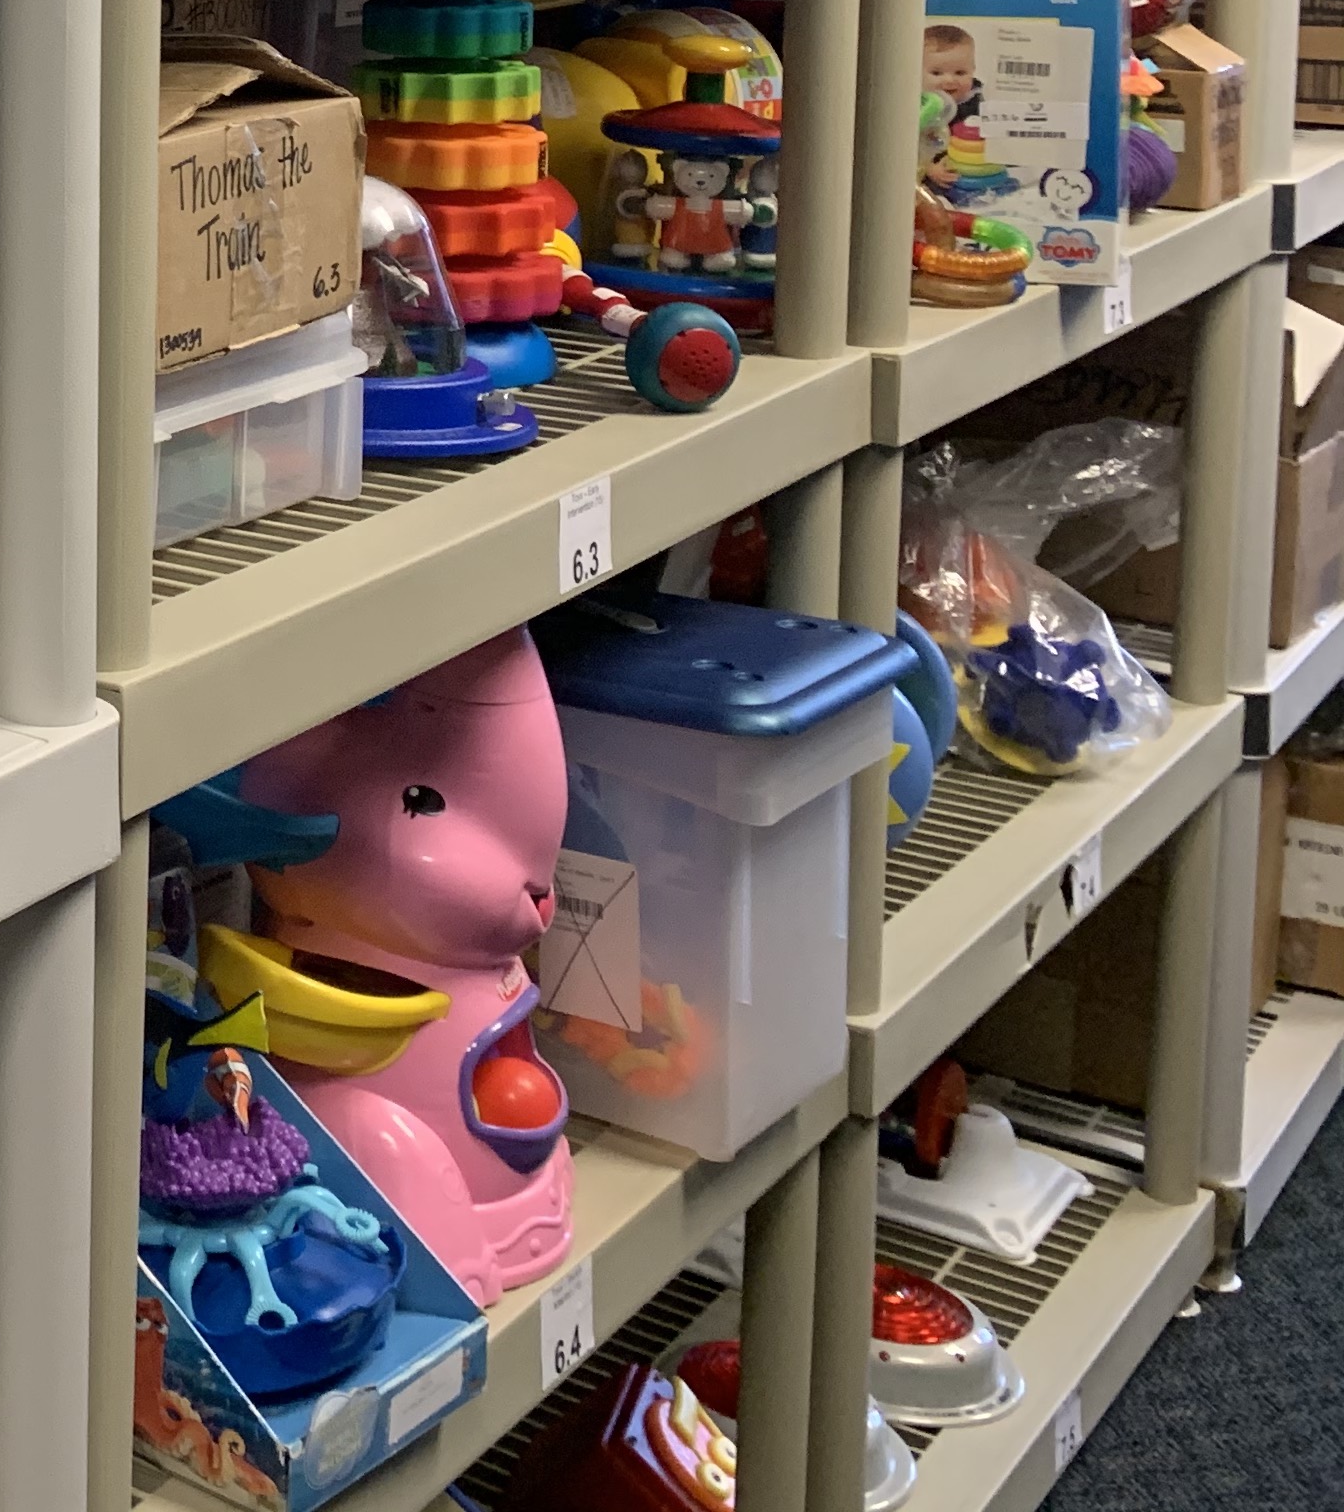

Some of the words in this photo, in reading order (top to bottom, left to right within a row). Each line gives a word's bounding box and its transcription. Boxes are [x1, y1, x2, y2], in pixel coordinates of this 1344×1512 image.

[171, 146, 266, 214] Thomas
[277, 135, 313, 190] the
[196, 211, 267, 282] Train
[1041, 244, 1098, 260] TOMY
[312, 262, 342, 300] 6.3
[573, 540, 600, 584] 6.3
[554, 1324, 582, 1375] 6.4
